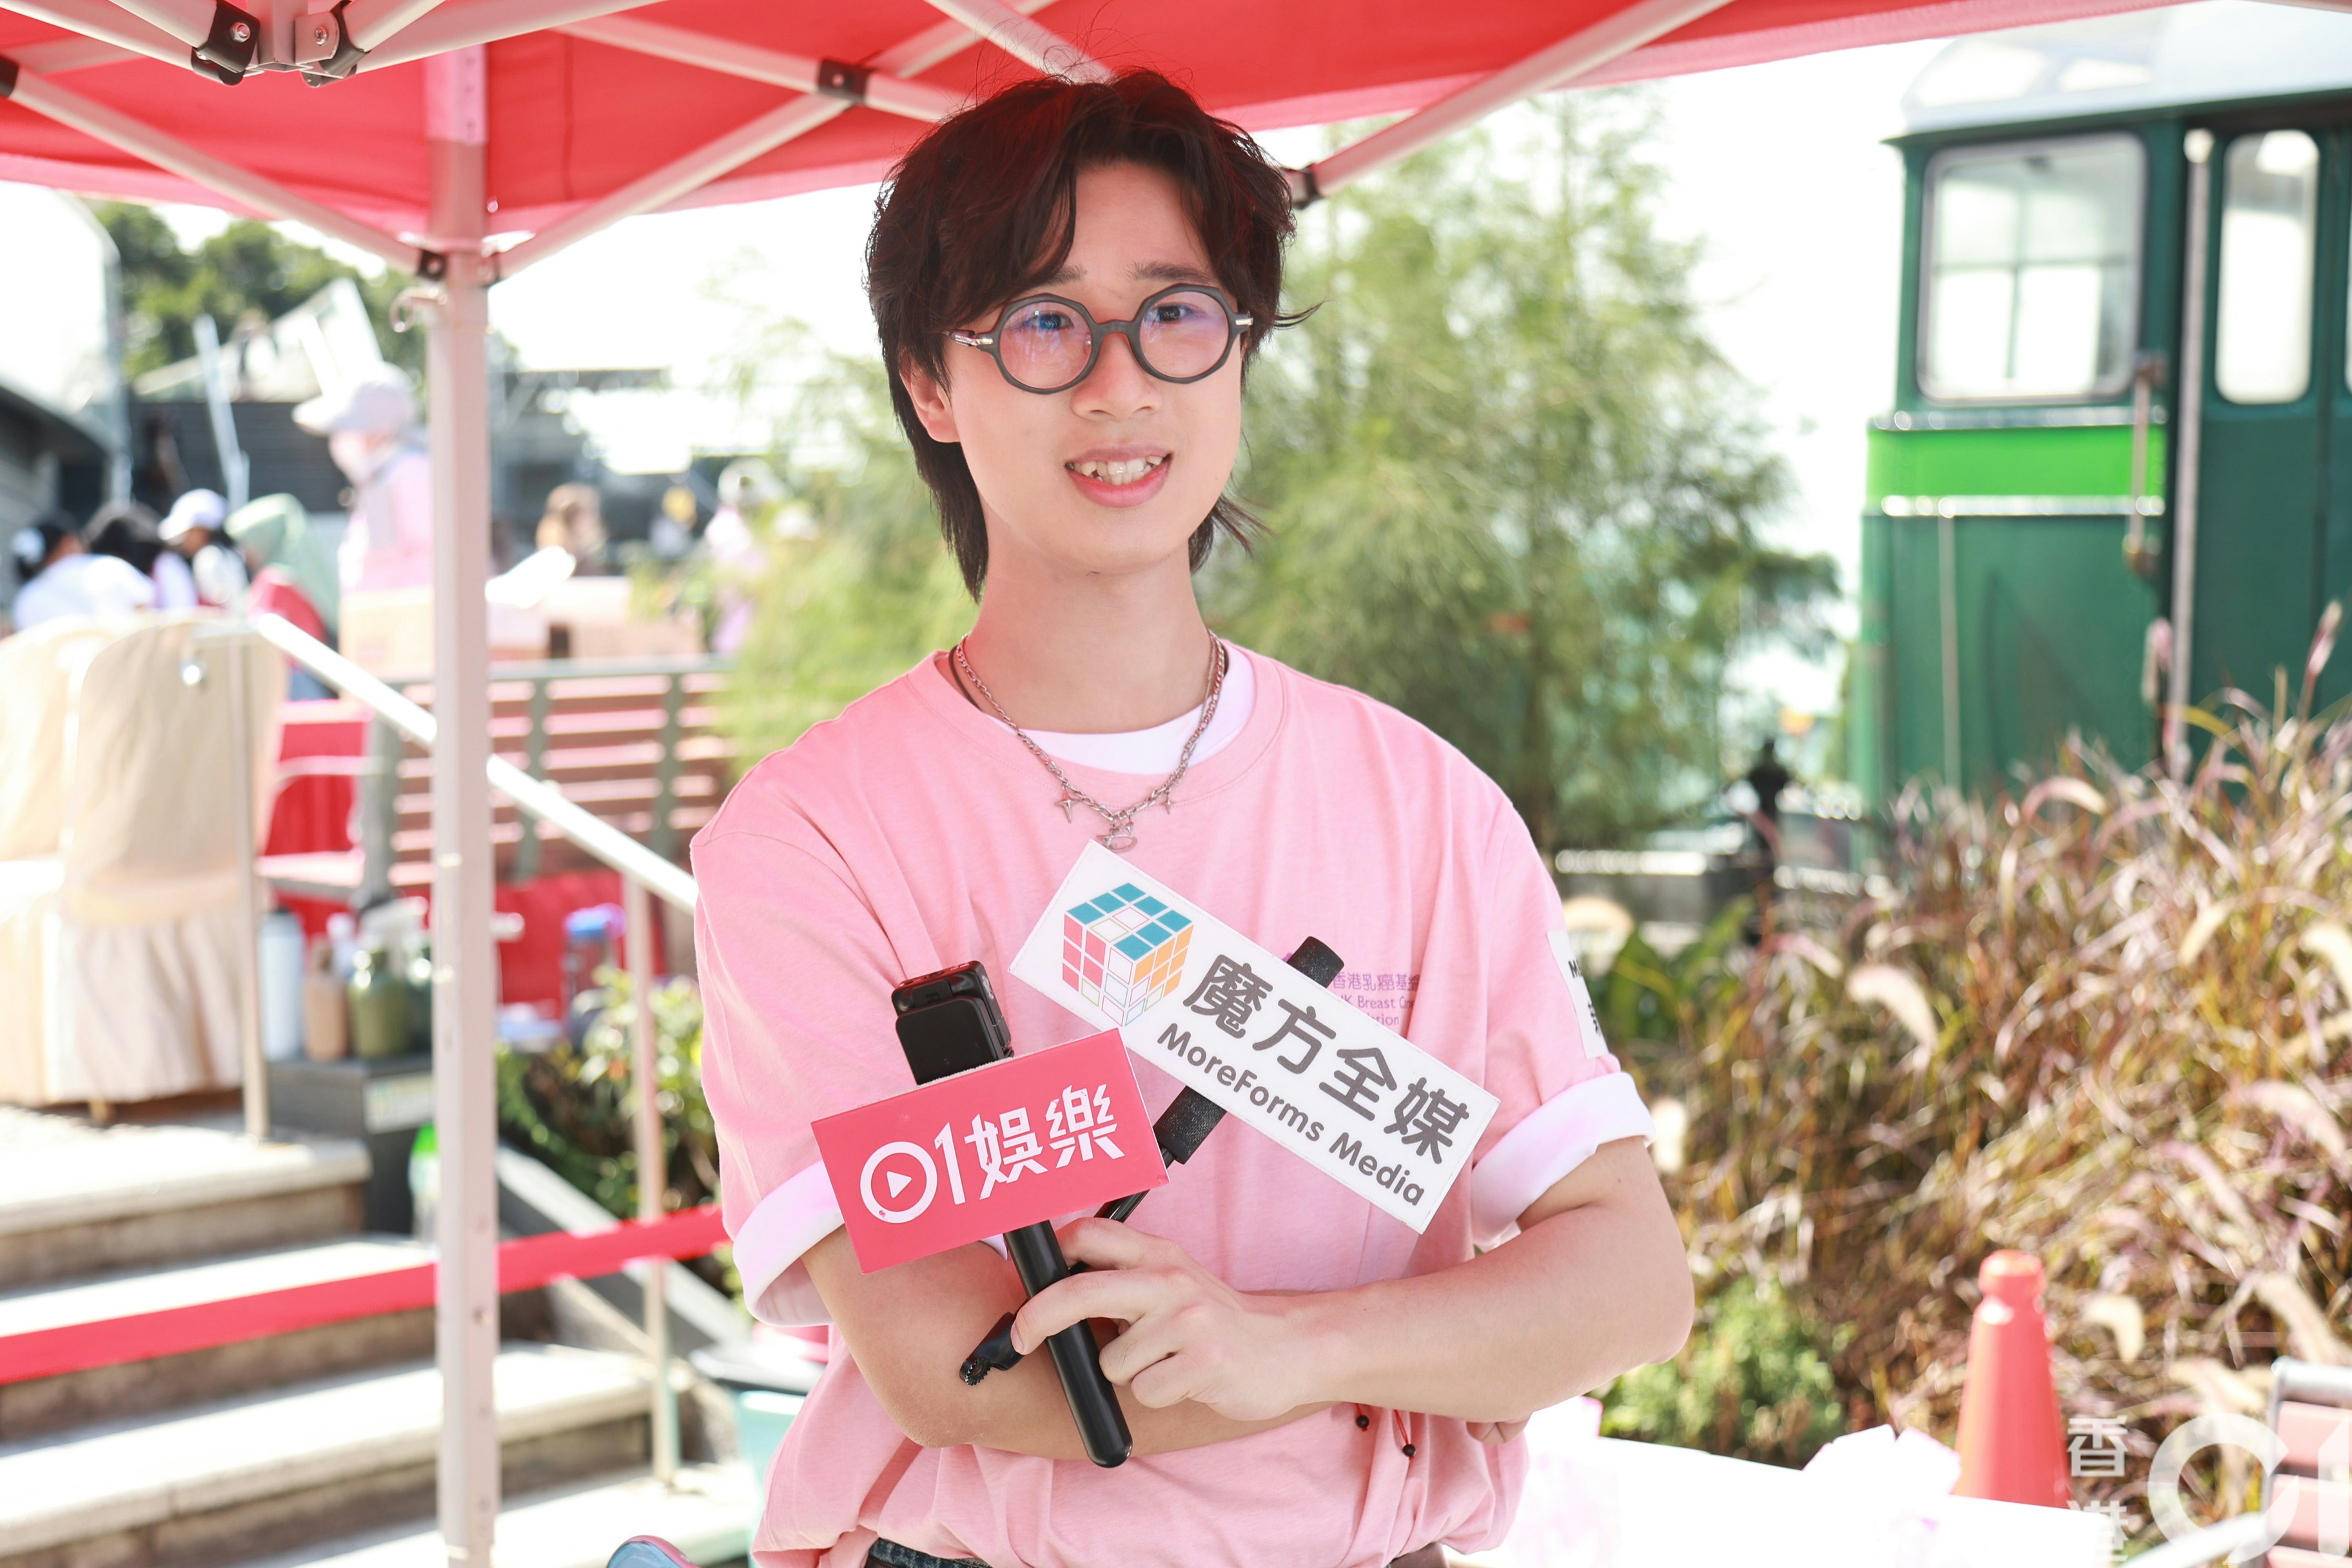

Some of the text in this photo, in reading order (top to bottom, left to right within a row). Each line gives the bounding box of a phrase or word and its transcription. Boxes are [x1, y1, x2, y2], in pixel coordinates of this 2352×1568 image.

[1182, 954, 1469, 1164] 魔方全媒
[1358, 995, 1396, 1009] Breast
[1157, 1023, 1425, 1206] MoreForms Media
